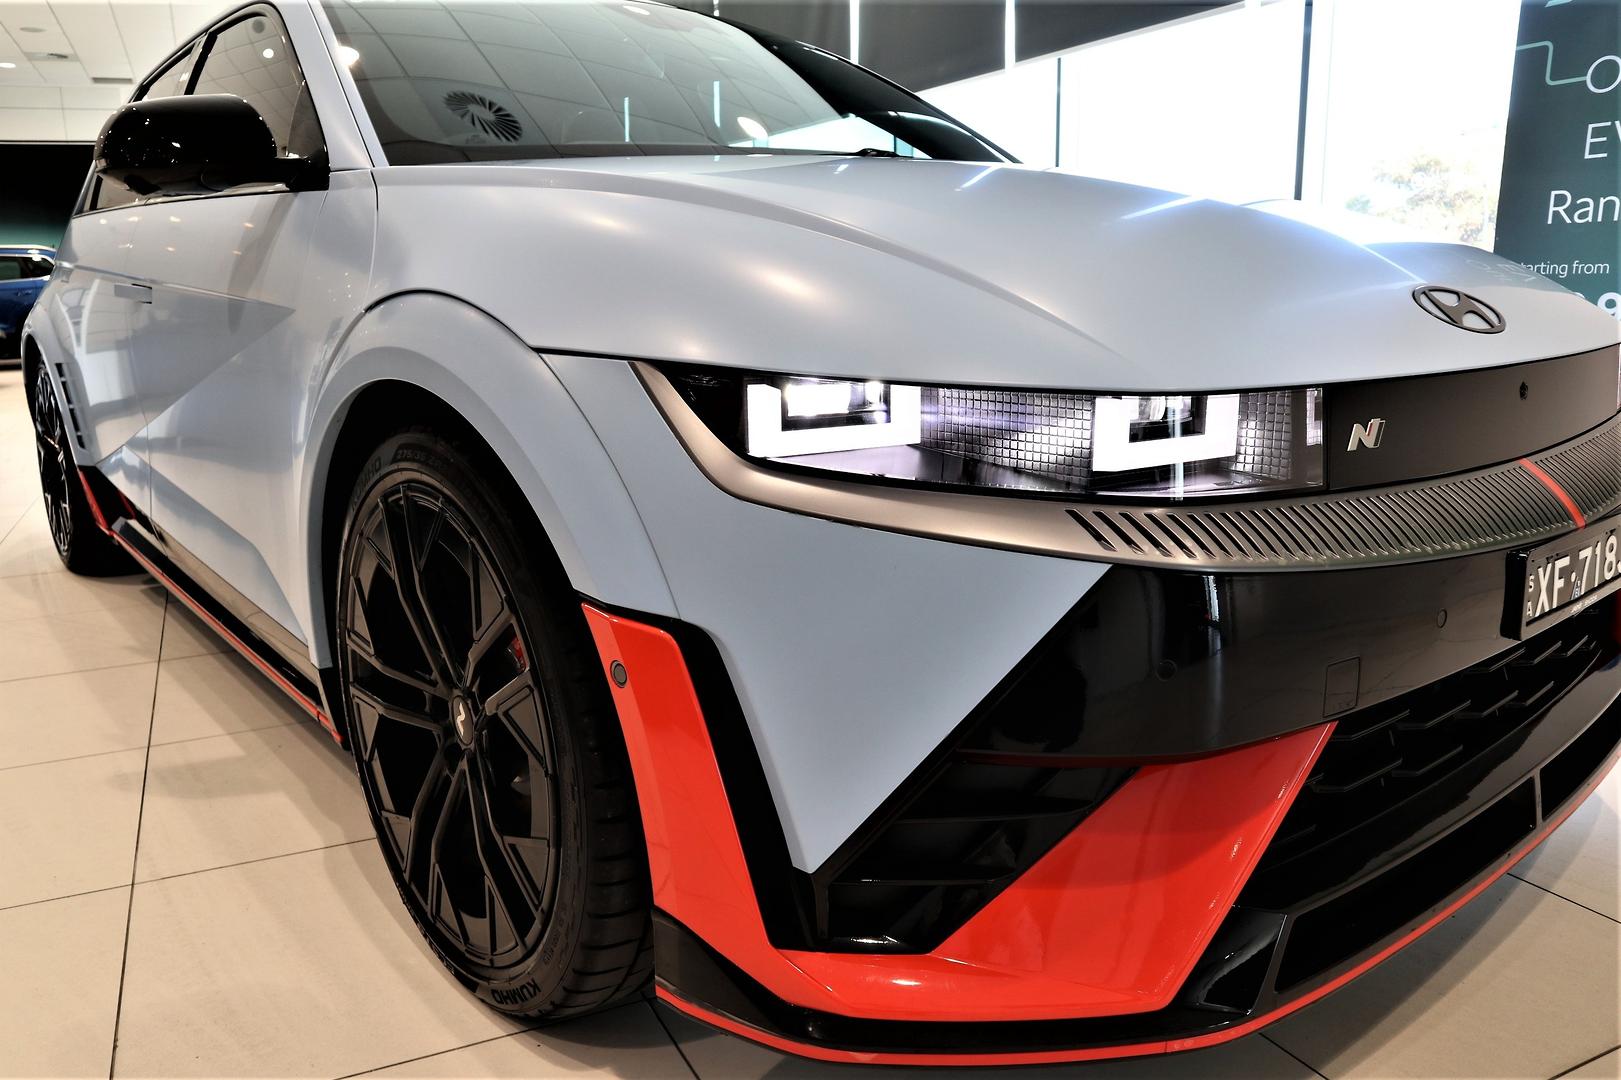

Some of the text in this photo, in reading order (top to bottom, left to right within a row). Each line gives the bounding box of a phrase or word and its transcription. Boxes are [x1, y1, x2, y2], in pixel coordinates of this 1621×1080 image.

[1584, 120, 1621, 159] E
[1547, 190, 1621, 225] Ran
[1521, 260, 1610, 278] arting from
[490, 977, 542, 1006] KUMHO
